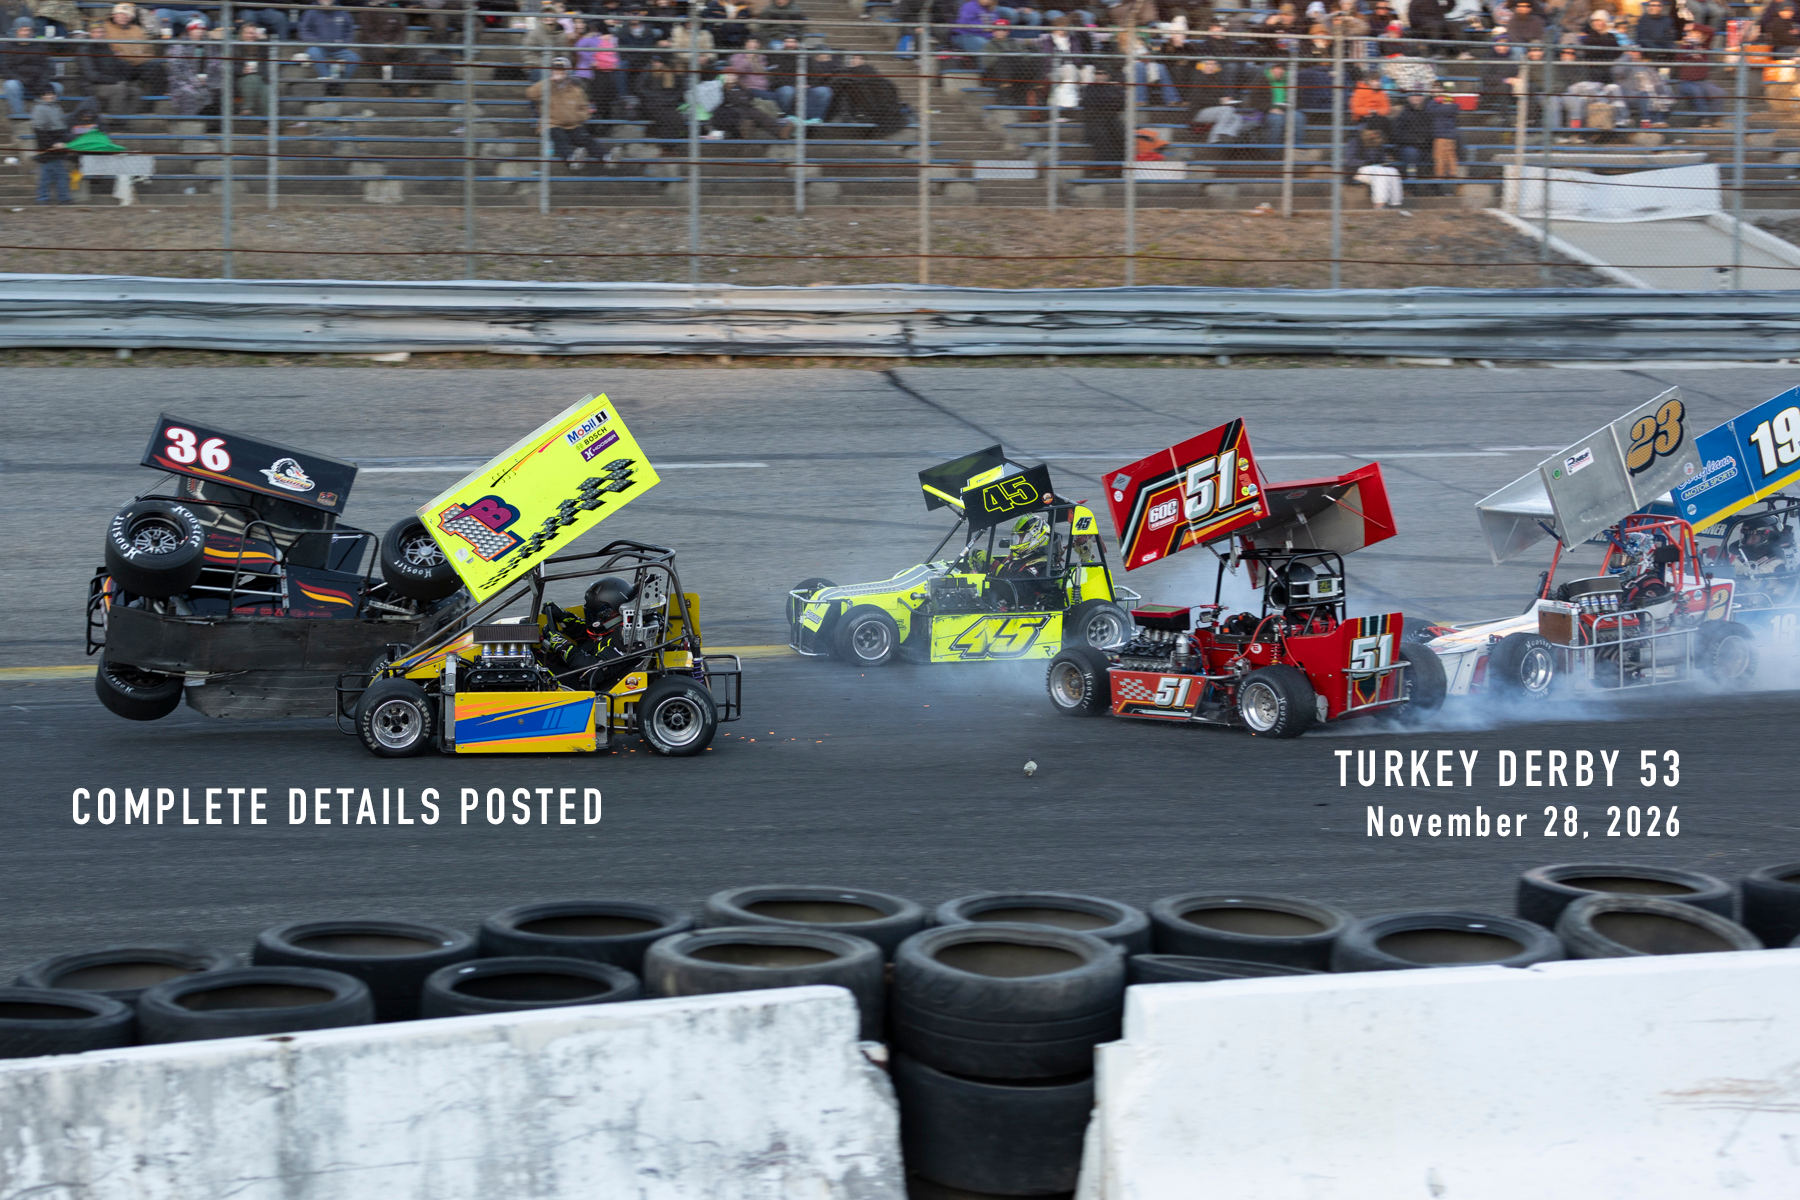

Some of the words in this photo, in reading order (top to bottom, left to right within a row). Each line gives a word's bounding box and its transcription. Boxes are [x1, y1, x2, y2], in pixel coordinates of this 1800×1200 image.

[164, 427, 232, 472] 36
[567, 418, 597, 443] Mobil
[584, 427, 607, 445] BOSCH
[1626, 399, 1685, 477] 23
[1749, 406, 1800, 478] 19
[983, 476, 1038, 512] 45
[1184, 449, 1238, 522] 51
[1685, 481, 1709, 498] MOTOR
[1711, 469, 1736, 486] SPORTS
[110, 515, 142, 560] Hoosier
[172, 505, 201, 547] Hoosier
[1075, 517, 1092, 530] 45
[394, 560, 432, 579] Hoosier
[948, 614, 1052, 659] 45
[1770, 613, 1797, 643] 19
[1350, 633, 1393, 681] 51
[1082, 672, 1094, 709] Hoosier
[1154, 676, 1193, 709] 51
[361, 710, 381, 751] Hoosier
[413, 698, 432, 739] Hoosier
[1274, 696, 1288, 734] Hoosier
